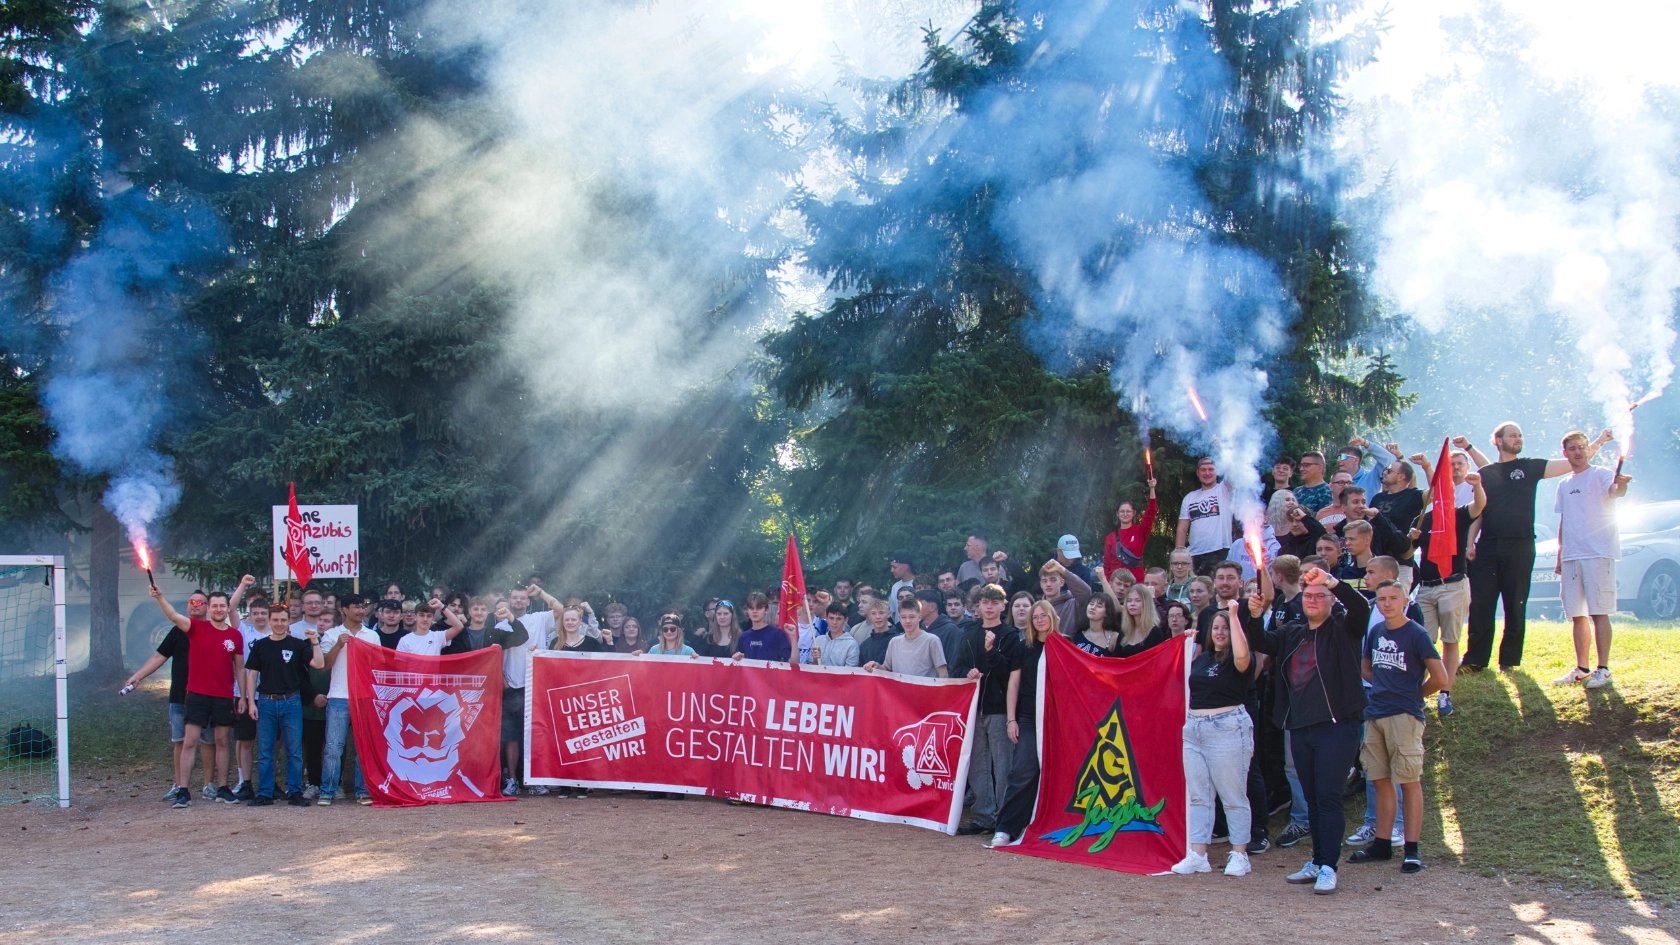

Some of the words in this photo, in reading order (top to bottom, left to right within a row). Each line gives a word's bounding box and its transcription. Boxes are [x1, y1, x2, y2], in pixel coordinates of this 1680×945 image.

[309, 549, 358, 577] ukunft!
[560, 689, 622, 715] UNSER
[667, 691, 757, 728] UNSER
[765, 698, 855, 739] LEBEN
[566, 705, 626, 732] LEBEN
[573, 720, 640, 751] gestalten
[602, 738, 647, 762] WIR!
[665, 727, 815, 774] GESTALTEN
[823, 742, 886, 784] WIR!
[936, 778, 955, 791] Zwic
